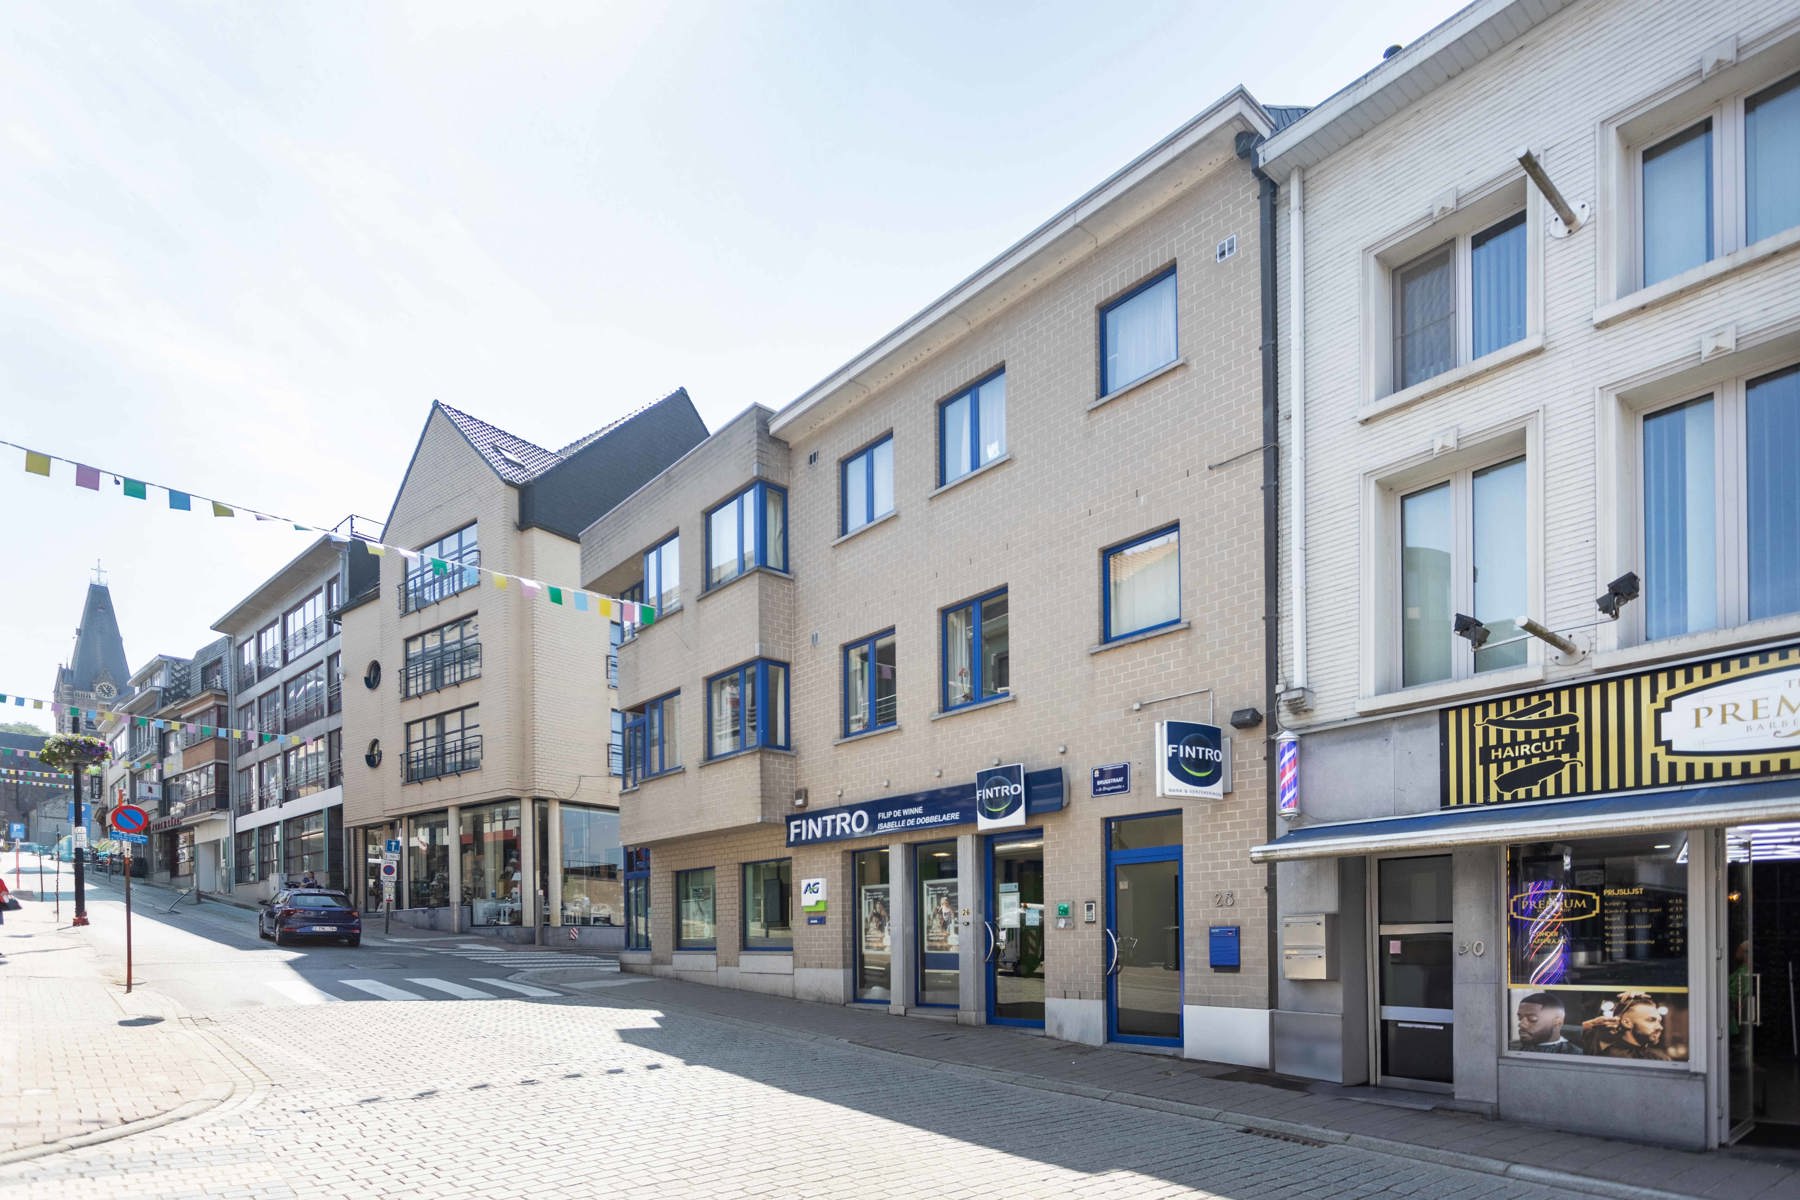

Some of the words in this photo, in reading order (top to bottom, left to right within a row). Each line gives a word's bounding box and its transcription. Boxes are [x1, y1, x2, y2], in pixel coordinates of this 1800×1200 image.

[1168, 744, 1222, 762] FINTRO
[1491, 738, 1566, 760] HAIRCUT
[976, 783, 1022, 801] FINTRO
[877, 810, 893, 820] FILIP
[893, 809, 902, 818] DE
[902, 806, 924, 816] WINNE
[877, 819, 906, 830] ISABELLE
[906, 818, 916, 826] DE
[916, 811, 960, 825] DOBBELAERE
[789, 809, 870, 843] FINTRO
[803, 881, 820, 895] AG
